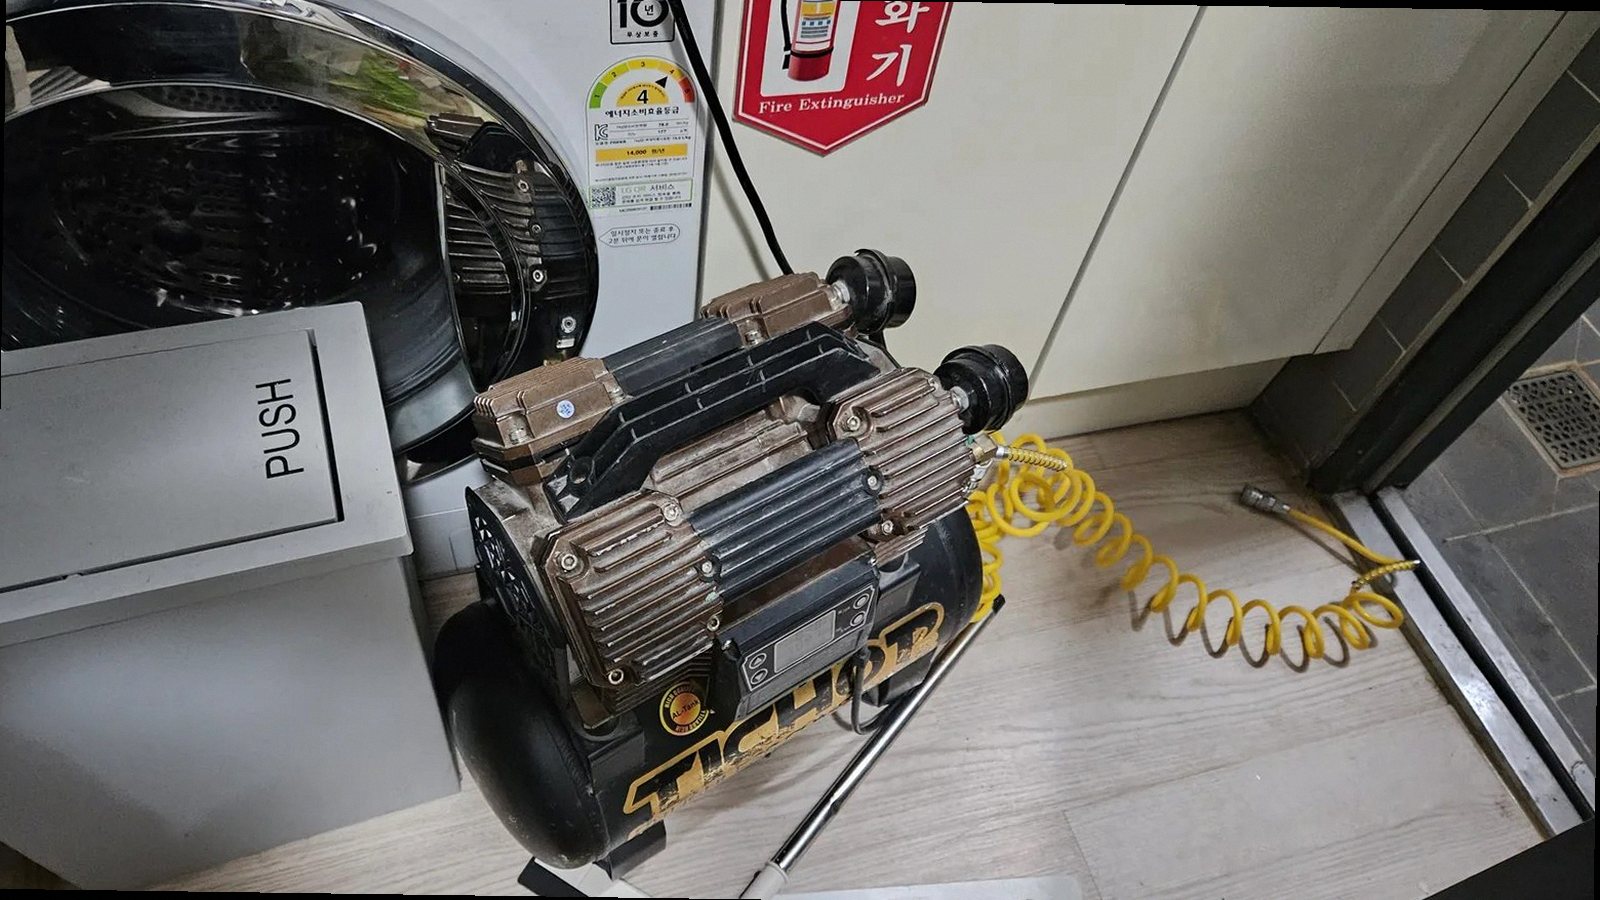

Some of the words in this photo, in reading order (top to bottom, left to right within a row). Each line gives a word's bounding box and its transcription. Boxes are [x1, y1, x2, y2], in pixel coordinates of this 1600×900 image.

[643, 4, 654, 16] 년
[636, 89, 649, 105] 4
[758, 101, 793, 114] Fire
[799, 93, 905, 112] Extinguisher
[605, 106, 680, 118] 에너지소비효율등급
[650, 183, 675, 192] 서비스
[610, 229, 637, 237] 일시정지
[638, 227, 652, 235] 또는
[255, 378, 305, 479] PUSH
[672, 699, 700, 719] AL-Tank
